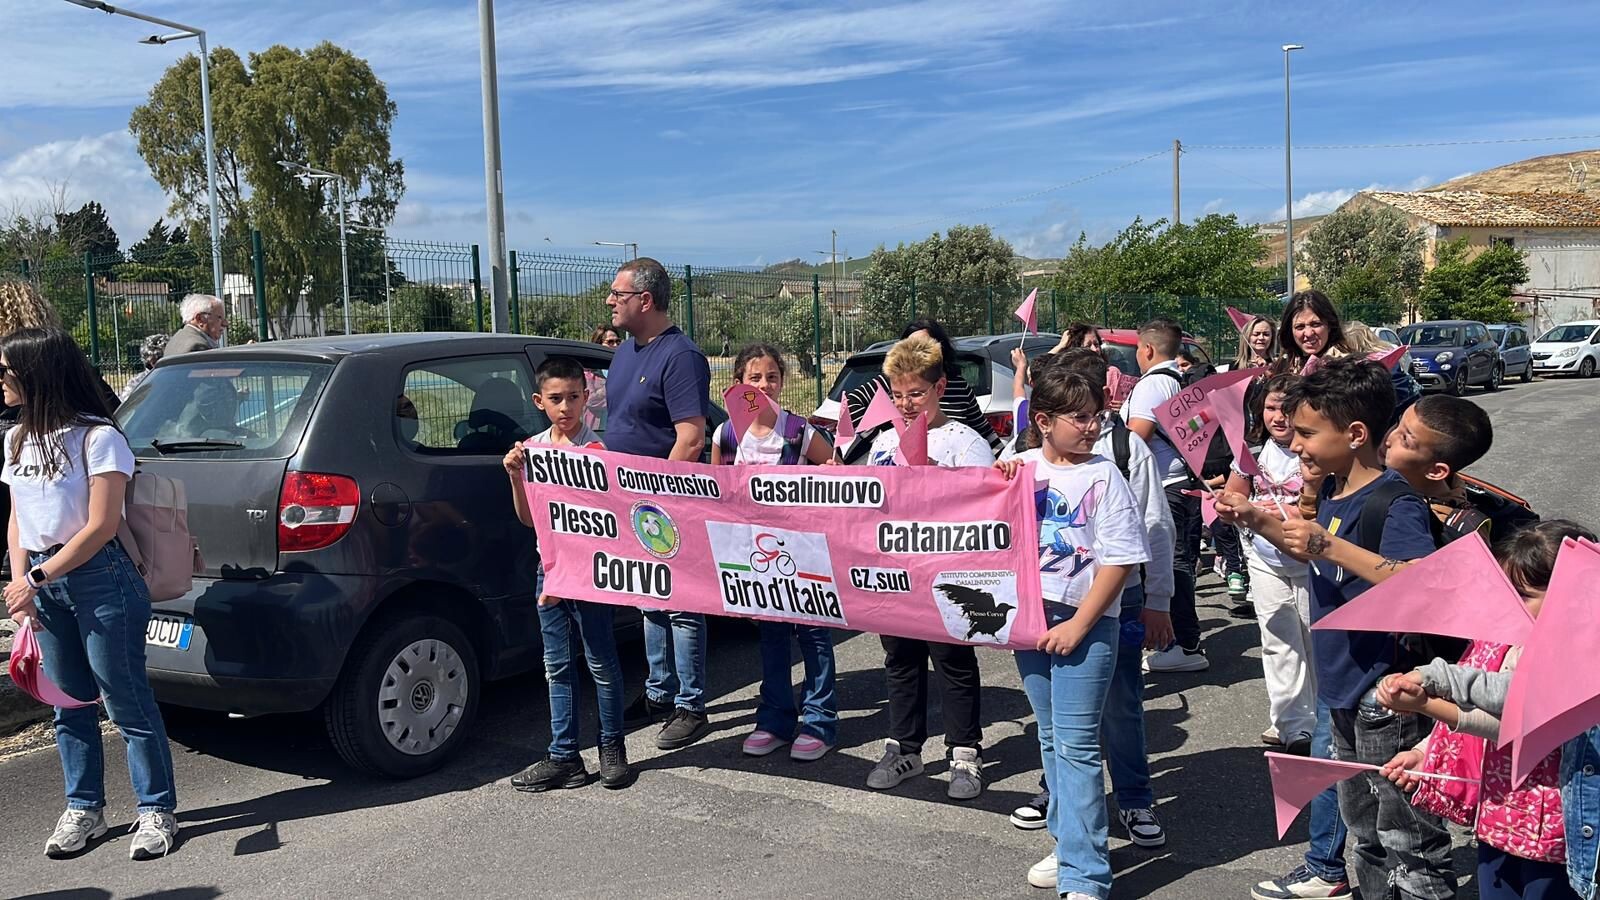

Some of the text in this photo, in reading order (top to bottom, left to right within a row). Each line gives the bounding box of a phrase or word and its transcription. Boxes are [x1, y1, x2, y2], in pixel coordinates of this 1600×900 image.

[1169, 386, 1205, 418] GIRO
[1187, 432, 1209, 452] 2026
[527, 448, 882, 504] Istituto Comprensivo Casalinuovo
[246, 509, 268, 520] TDI
[549, 502, 618, 538] Plesso
[878, 522, 1012, 553] Catanzaro
[593, 552, 672, 597] Corvo
[721, 570, 842, 619] Giro d'Italia
